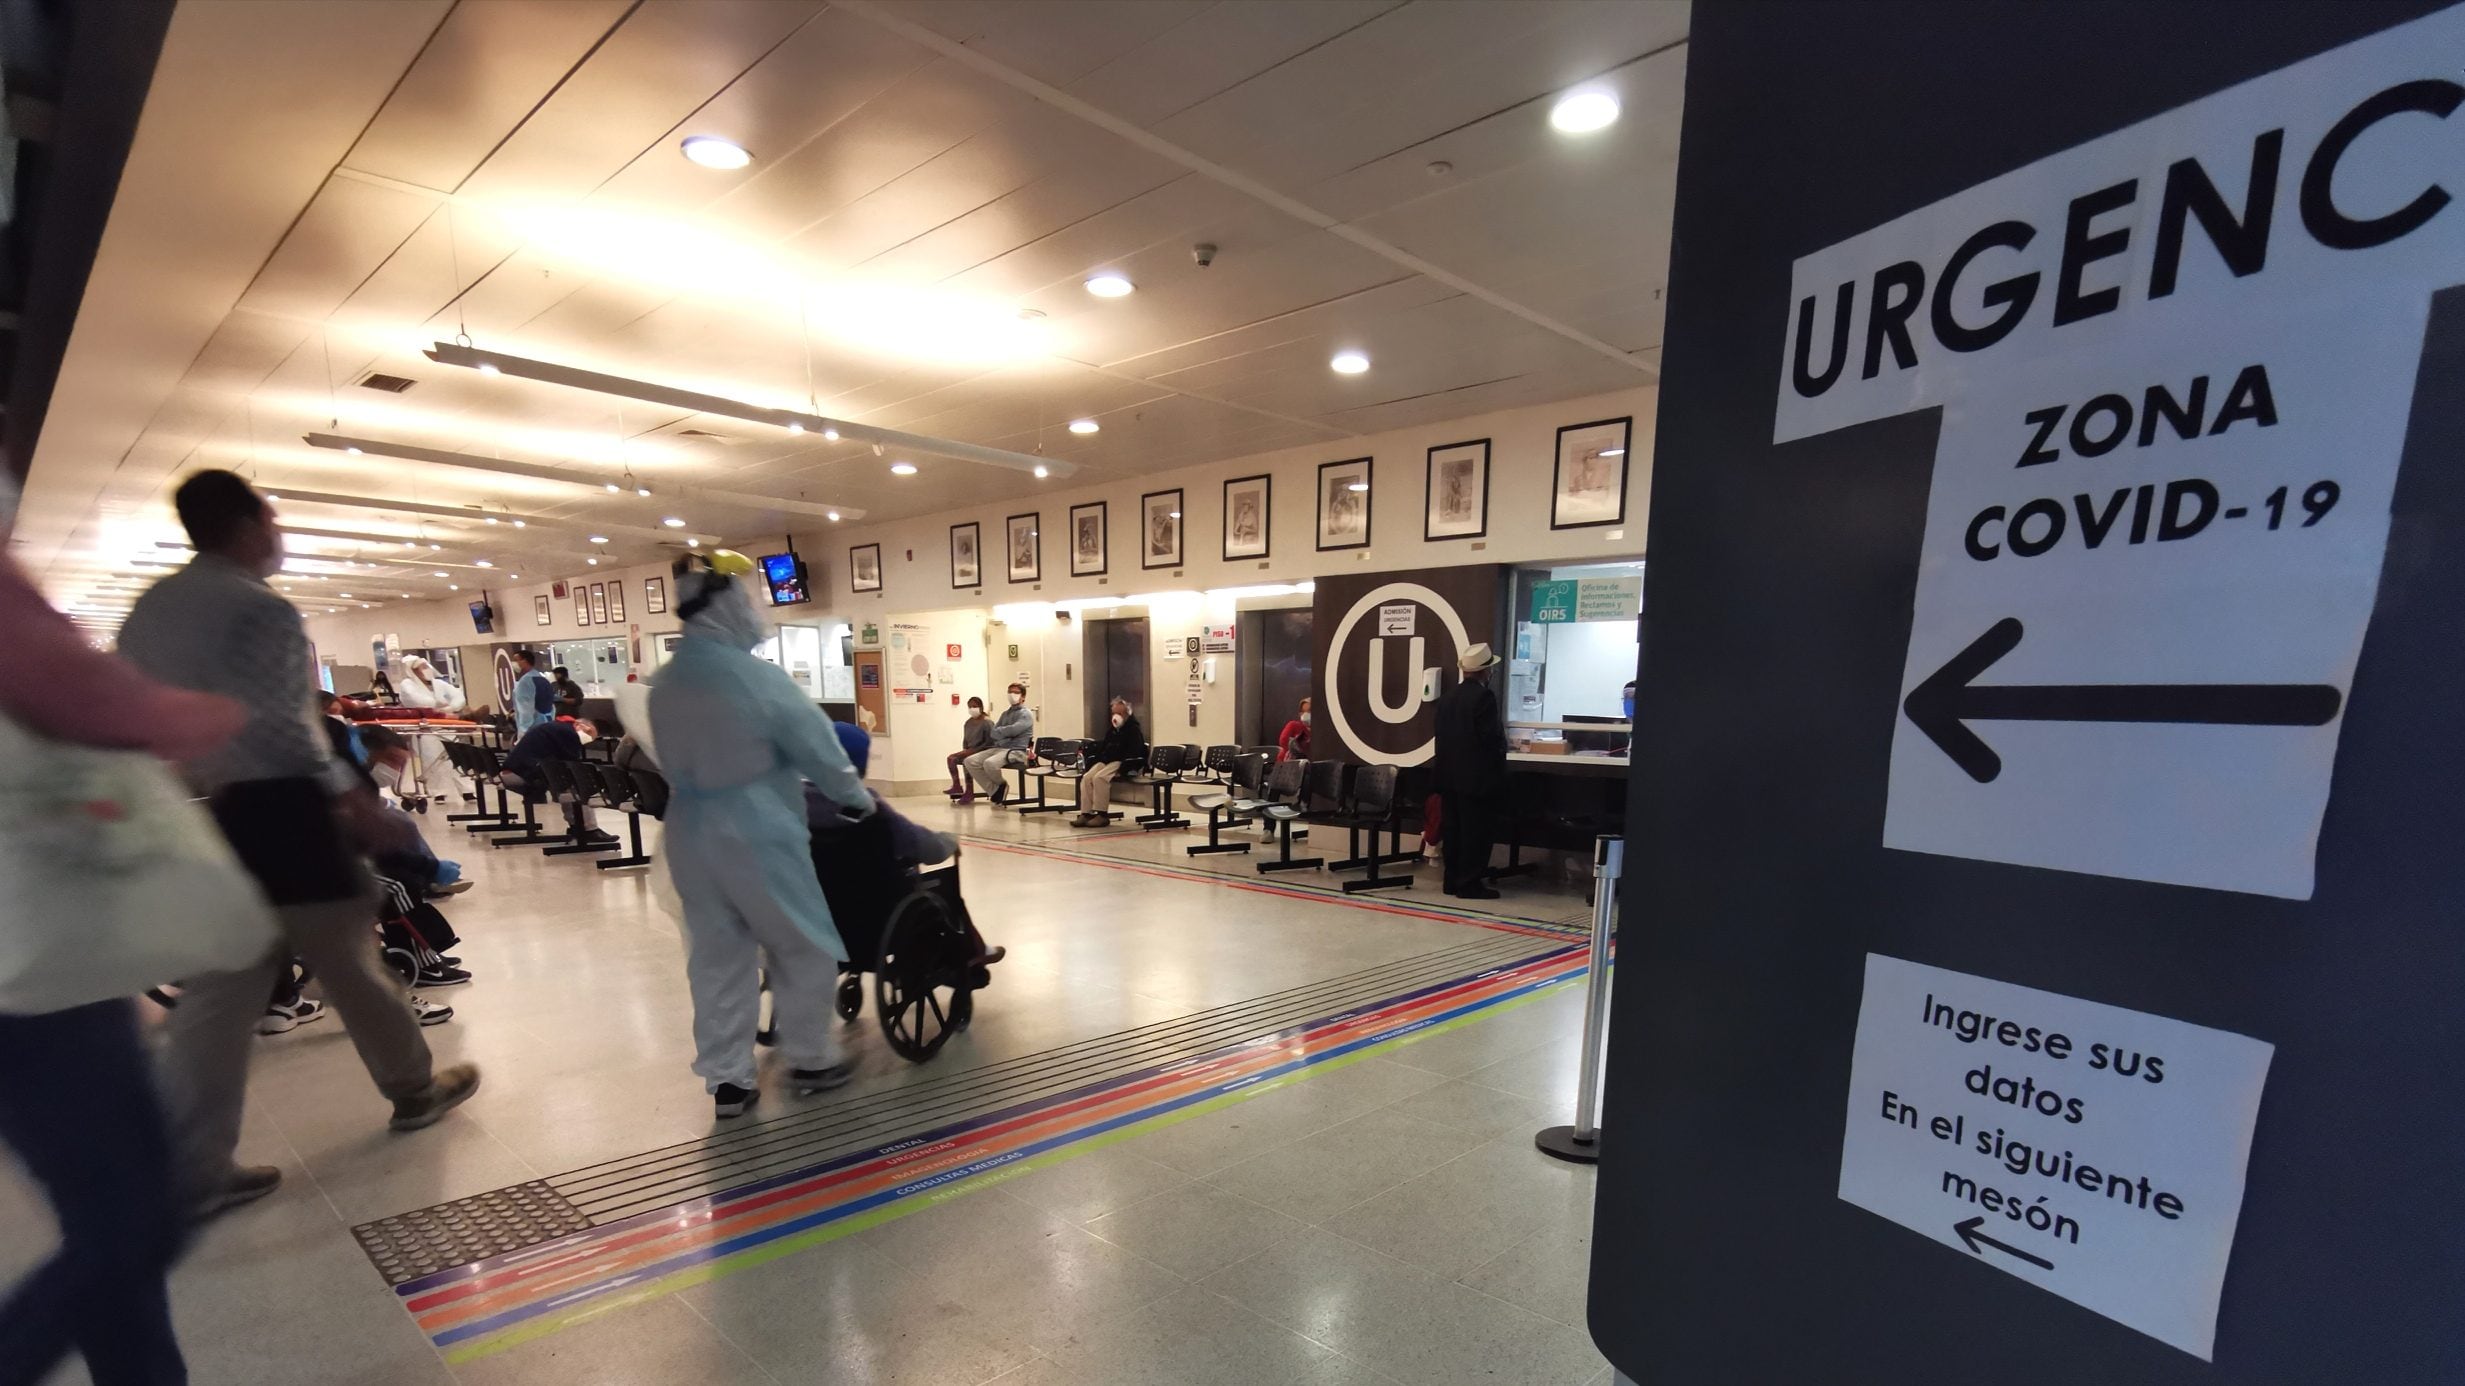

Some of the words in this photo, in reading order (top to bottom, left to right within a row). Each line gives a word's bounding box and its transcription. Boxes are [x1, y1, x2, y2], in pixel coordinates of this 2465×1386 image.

[1792, 78, 2465, 399] URGENC
[2014, 364, 2279, 469] ZONA
[1964, 478, 2341, 562] COVID-19
[1539, 609, 1567, 621] OIRS
[1580, 601, 1615, 609] Reclamos
[1581, 584, 1607, 592] Oficina
[1609, 583, 1619, 591] de
[499, 667, 511, 701] U
[1368, 637, 1425, 724] U
[1923, 993, 2073, 1060] Ingrese
[2088, 1043, 2164, 1084] sus
[1964, 1064, 2084, 1124] datos
[878, 1138, 927, 1155] DENTAL
[886, 1141, 956, 1165] URGENCIAS
[896, 1169, 969, 1195] CONSULTAS
[969, 1152, 1024, 1175] MEDICAS
[1881, 1090, 1918, 1130] En
[1930, 1115, 1964, 1146] el
[1975, 1130, 2184, 1220] siguiente
[1942, 1171, 2080, 1245] mesón
